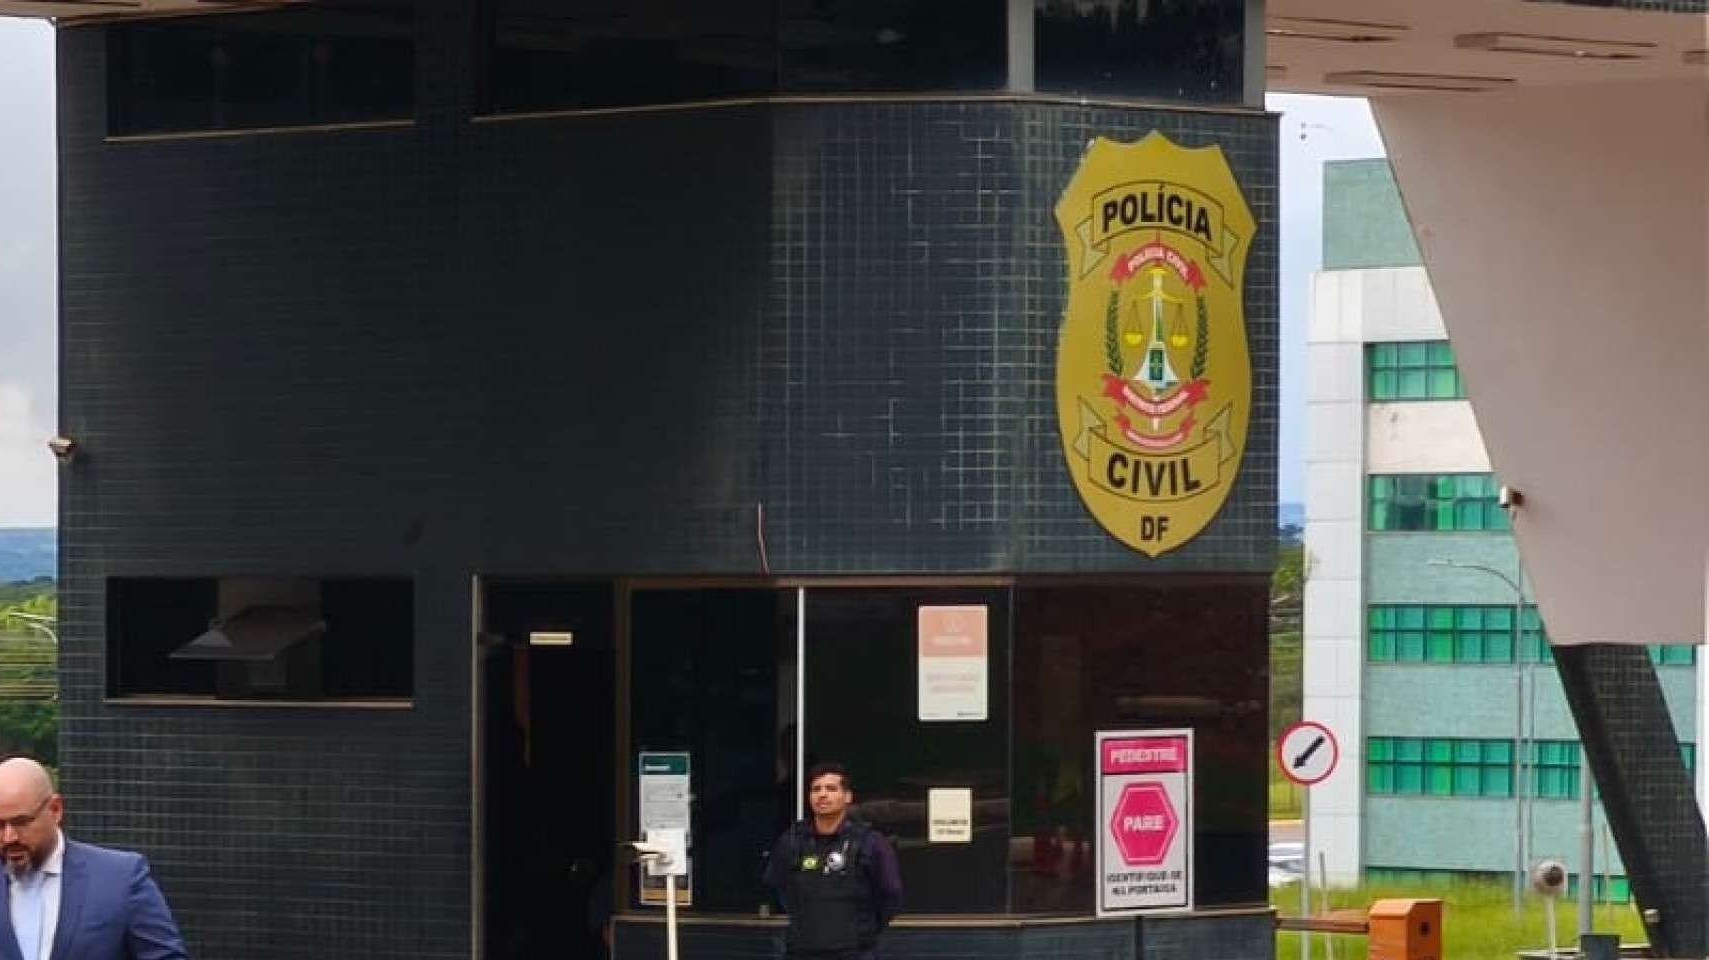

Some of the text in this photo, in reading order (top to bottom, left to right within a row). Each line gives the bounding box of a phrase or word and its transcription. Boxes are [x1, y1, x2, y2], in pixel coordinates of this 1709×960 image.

[1102, 183, 1212, 242] POLÍCIA
[1106, 454, 1201, 497] CIVIL
[1140, 516, 1169, 542] DF
[1110, 747, 1179, 764] PEDESTRE
[1124, 814, 1164, 832] PARE
